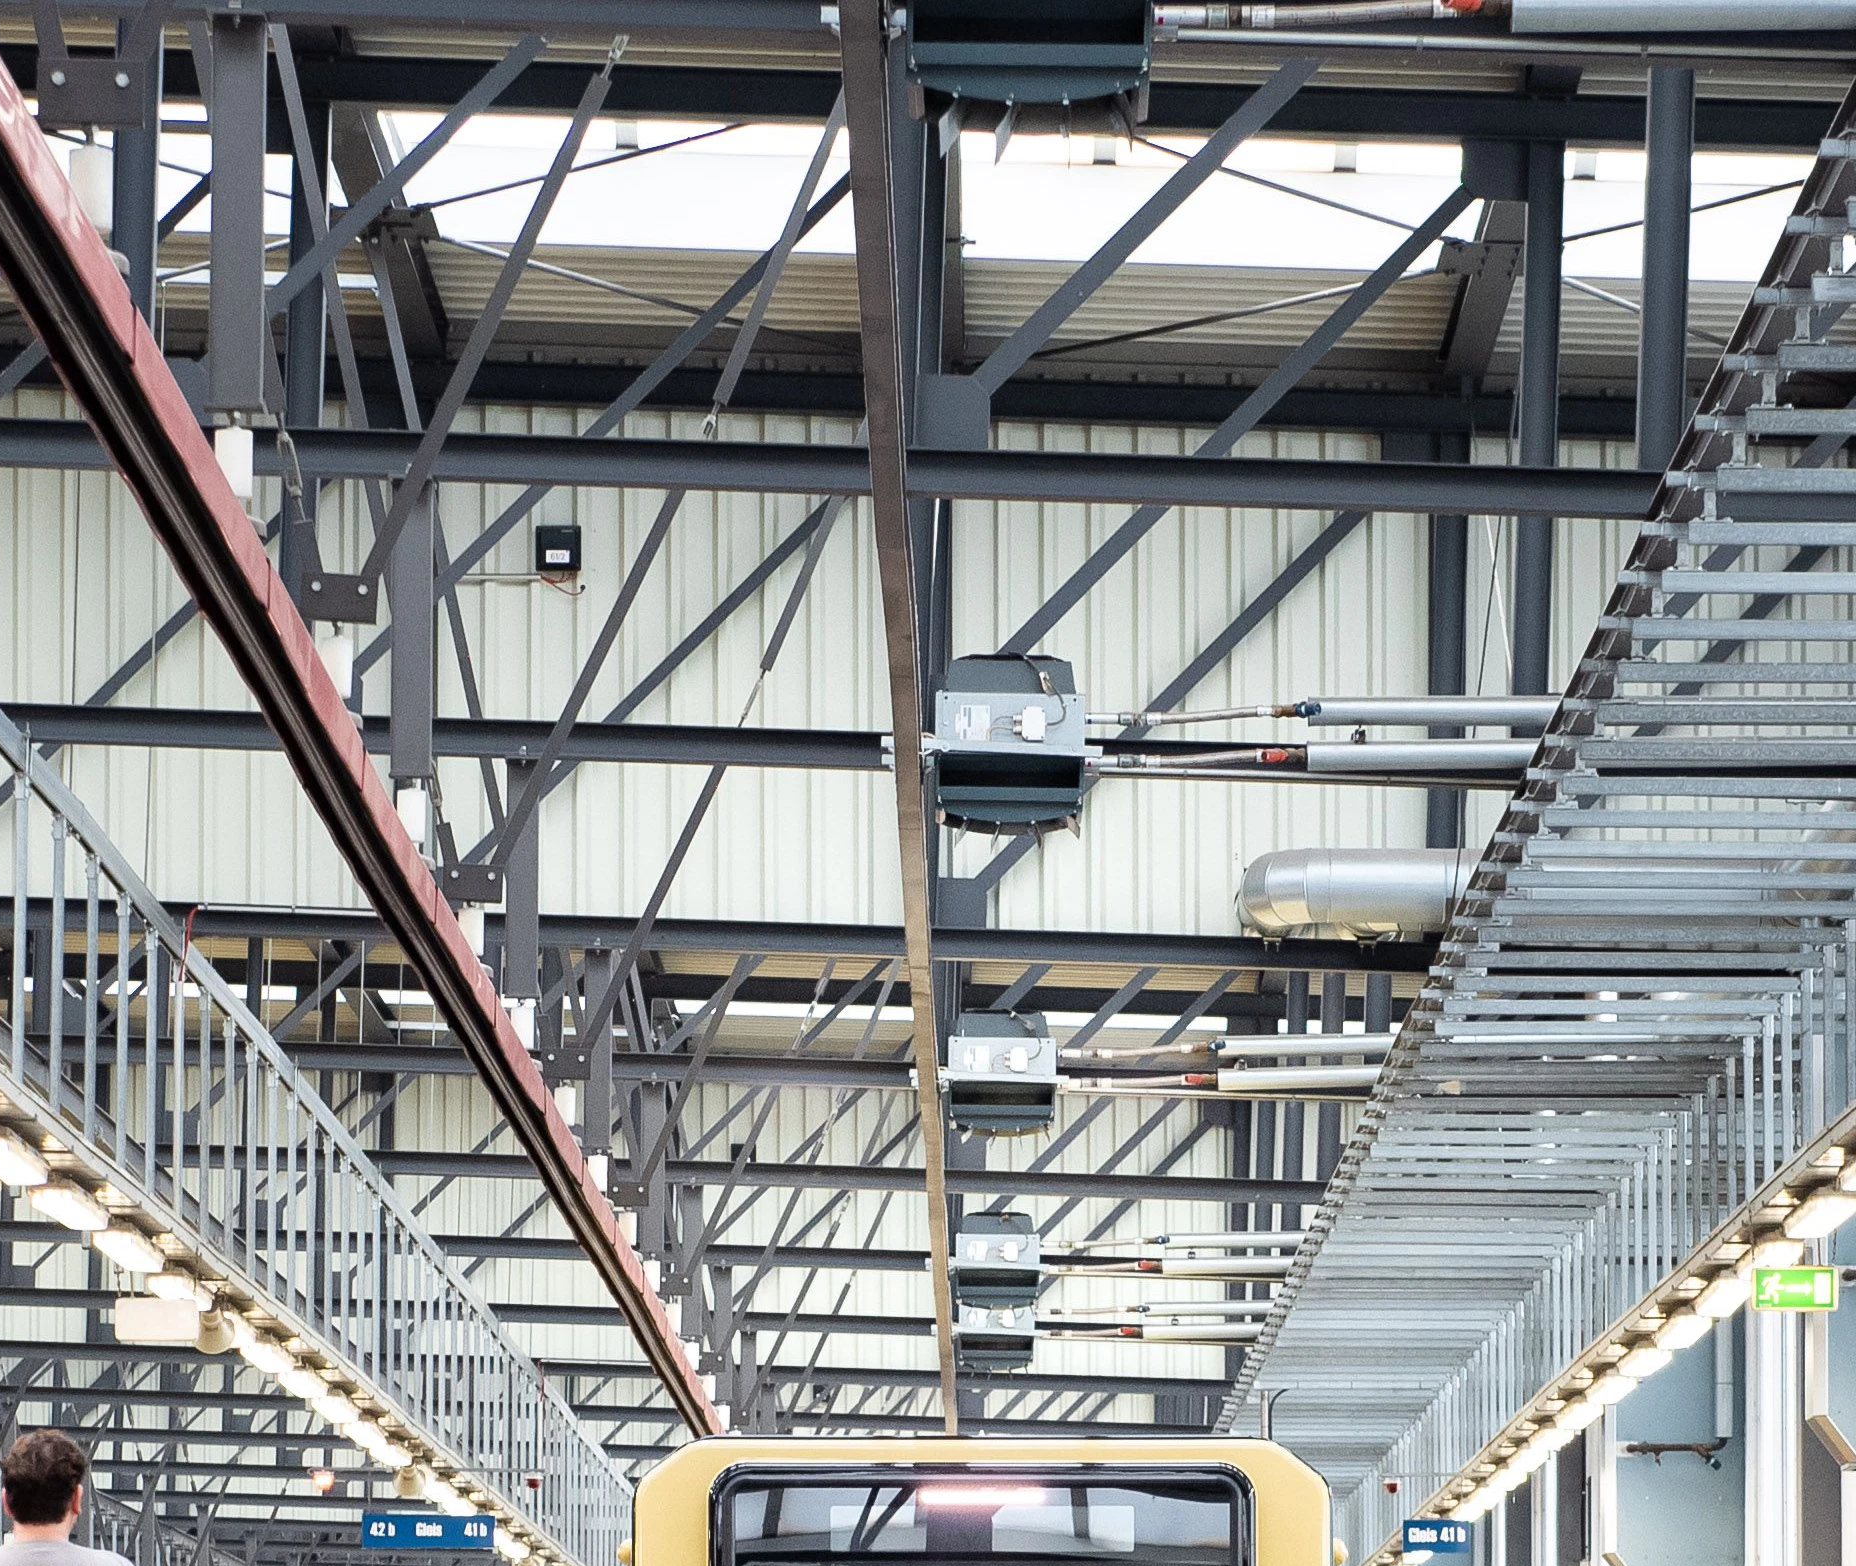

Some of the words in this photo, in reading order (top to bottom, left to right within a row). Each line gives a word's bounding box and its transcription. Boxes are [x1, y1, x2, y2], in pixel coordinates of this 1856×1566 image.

[369, 1522, 386, 1537] 42
[388, 1522, 396, 1537] b
[415, 1522, 443, 1537] Gleis
[463, 1522, 478, 1537] 41
[480, 1522, 488, 1537] b
[1408, 1527, 1438, 1543] Gleis
[1439, 1526, 1455, 1542] 41
[1457, 1526, 1466, 1542] b
